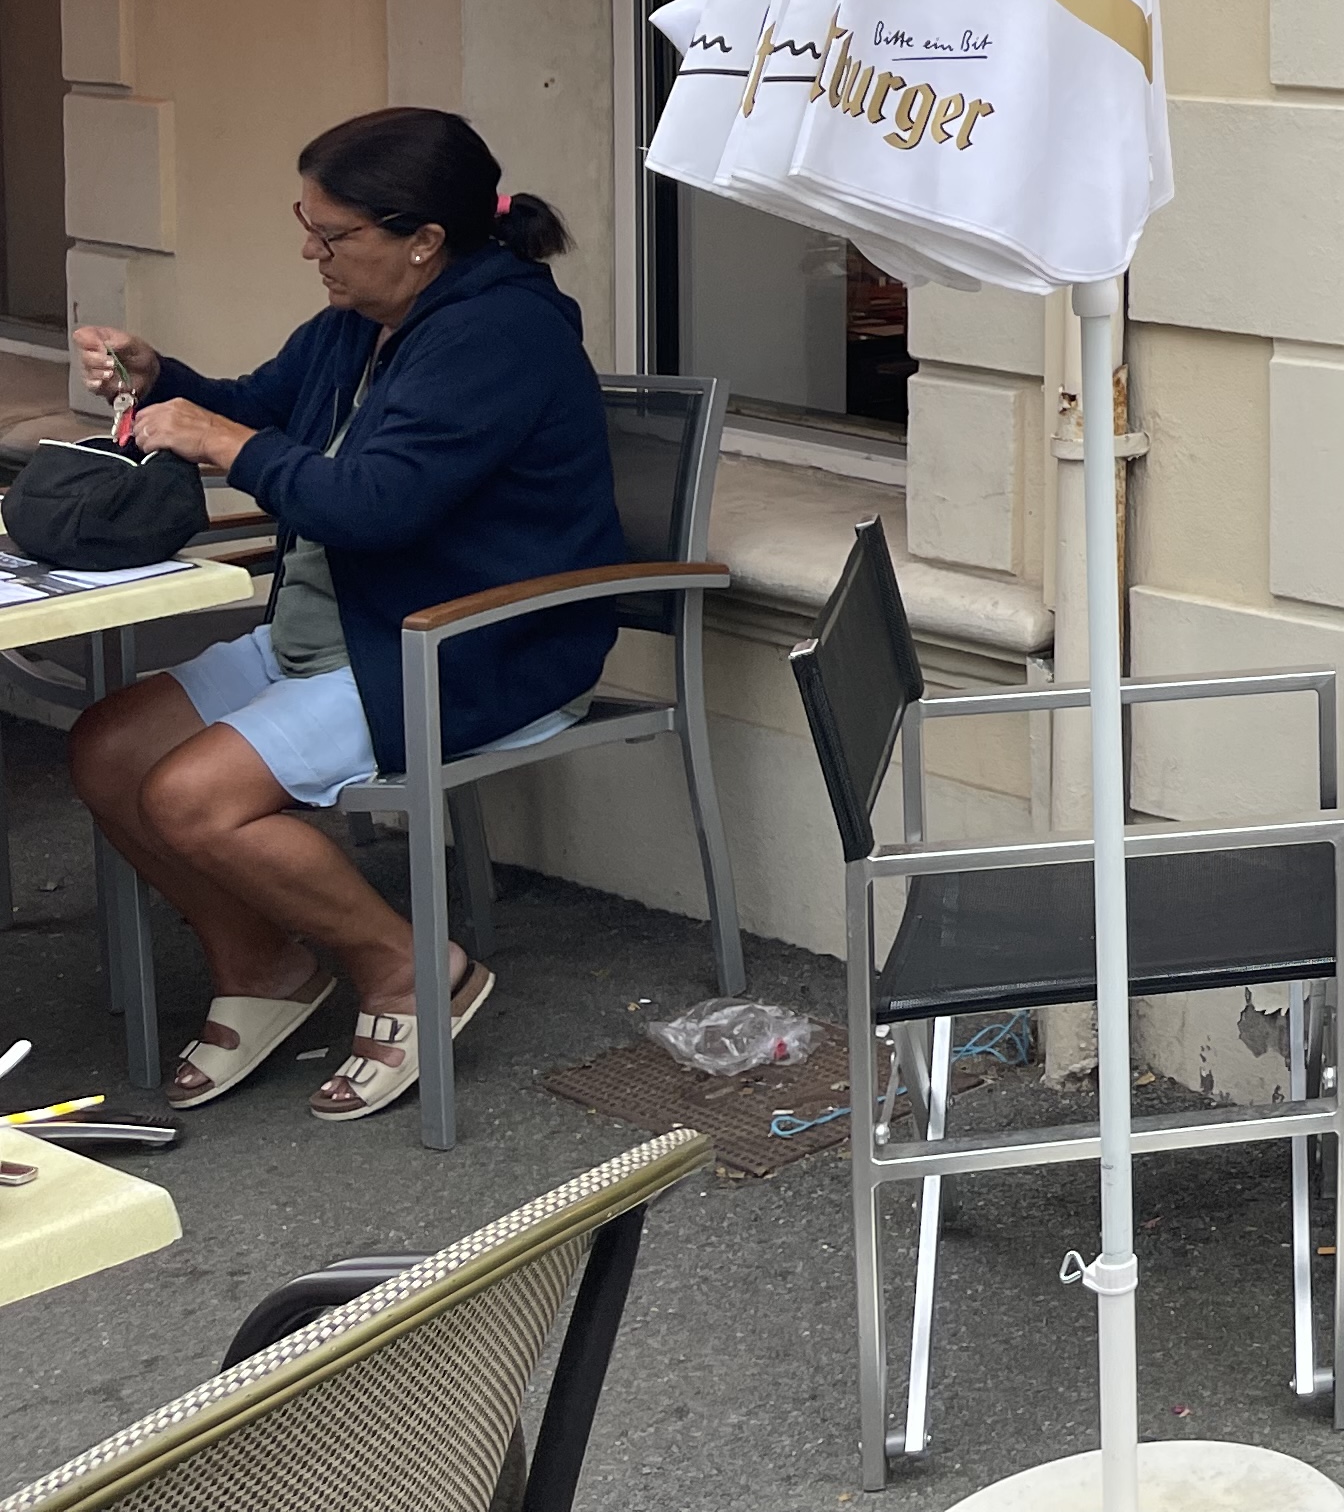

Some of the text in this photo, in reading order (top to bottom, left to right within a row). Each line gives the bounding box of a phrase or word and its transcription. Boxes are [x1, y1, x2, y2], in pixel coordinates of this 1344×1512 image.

[873, 21, 994, 53] Bitte ein Bit
